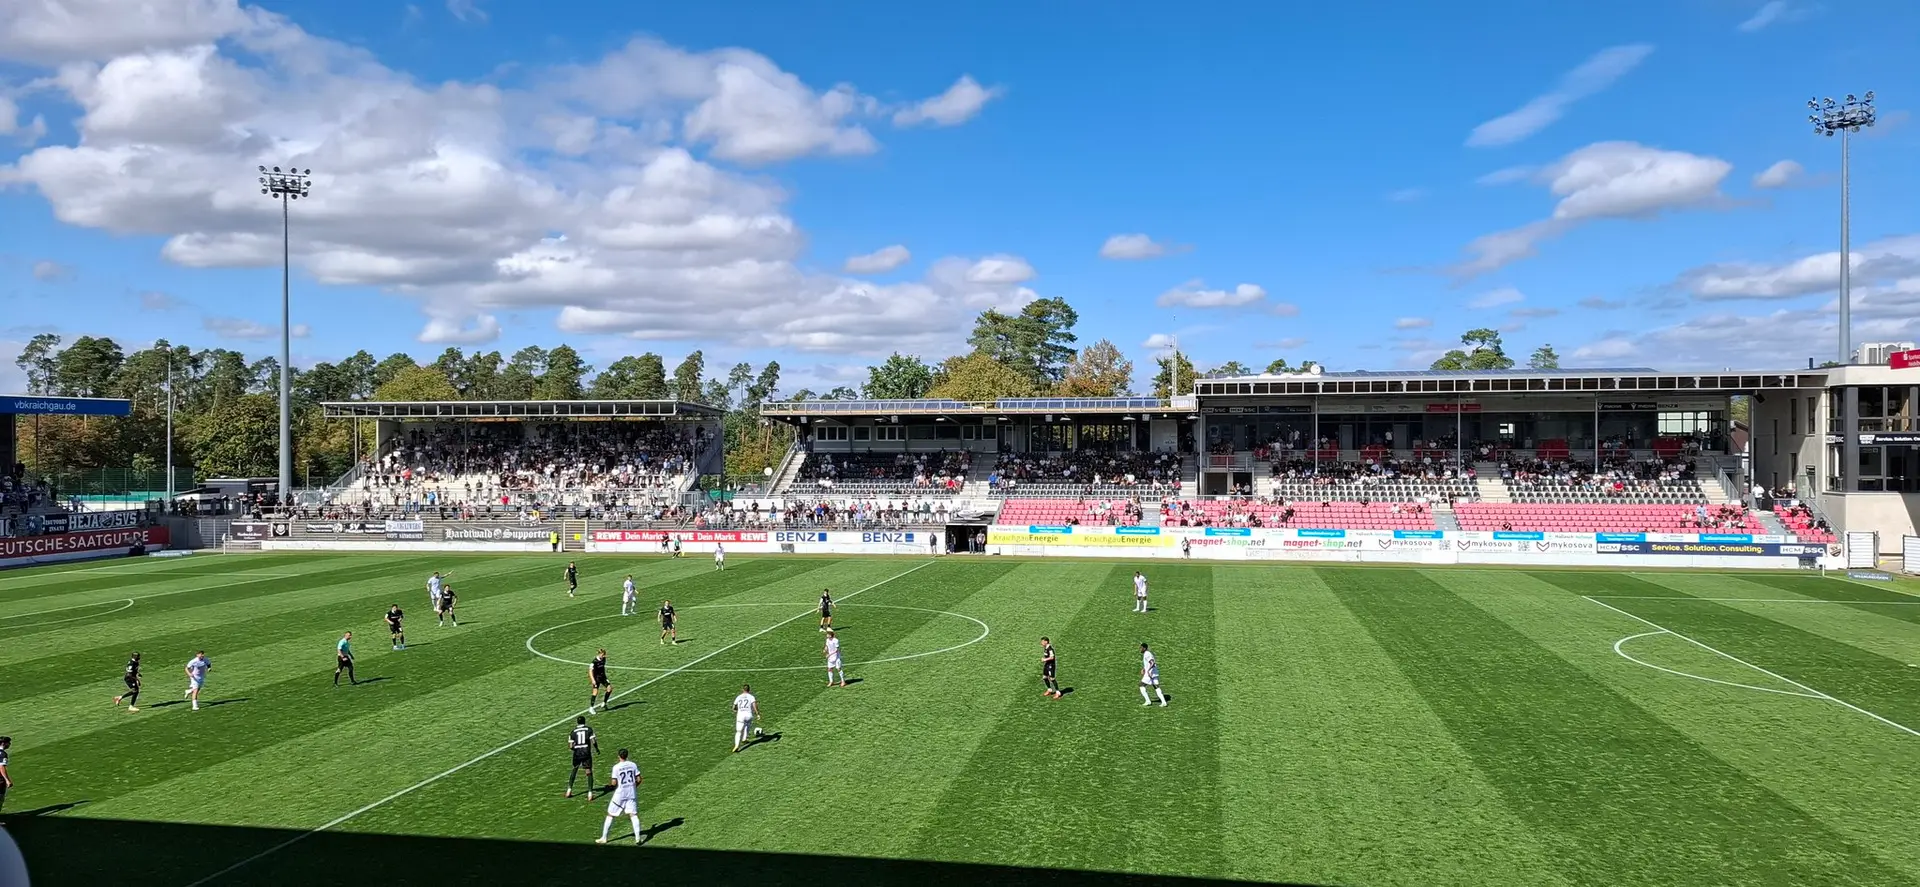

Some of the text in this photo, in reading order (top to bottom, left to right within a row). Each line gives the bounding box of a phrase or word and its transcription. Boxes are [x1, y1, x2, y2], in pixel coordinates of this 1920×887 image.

[14, 400, 76, 411] vbkraichgau.de
[68, 514, 100, 530] HEJA
[115, 512, 137, 527] SVS
[445, 528, 551, 540] Hardtwald Supporter
[596, 532, 622, 540] REWE
[625, 532, 641, 540] Dein
[697, 533, 713, 541] Dein
[714, 533, 735, 541] Markt
[741, 533, 767, 541] REWE
[776, 532, 816, 542] BENZ
[862, 533, 901, 543] BENZ
[0, 530, 149, 555] EUTSCHE-SAATGUTDE
[1189, 538, 1265, 547] magnet-shop.net
[1283, 539, 1362, 549] magnet-shop.net
[1471, 540, 1512, 548] mykosova
[1550, 541, 1593, 549] mykosova
[1683, 544, 1718, 552] Solution.
[1720, 545, 1764, 554] Consulting.
[738, 699, 749, 709] 22
[576, 730, 586, 744] 11
[619, 770, 634, 785] 23
